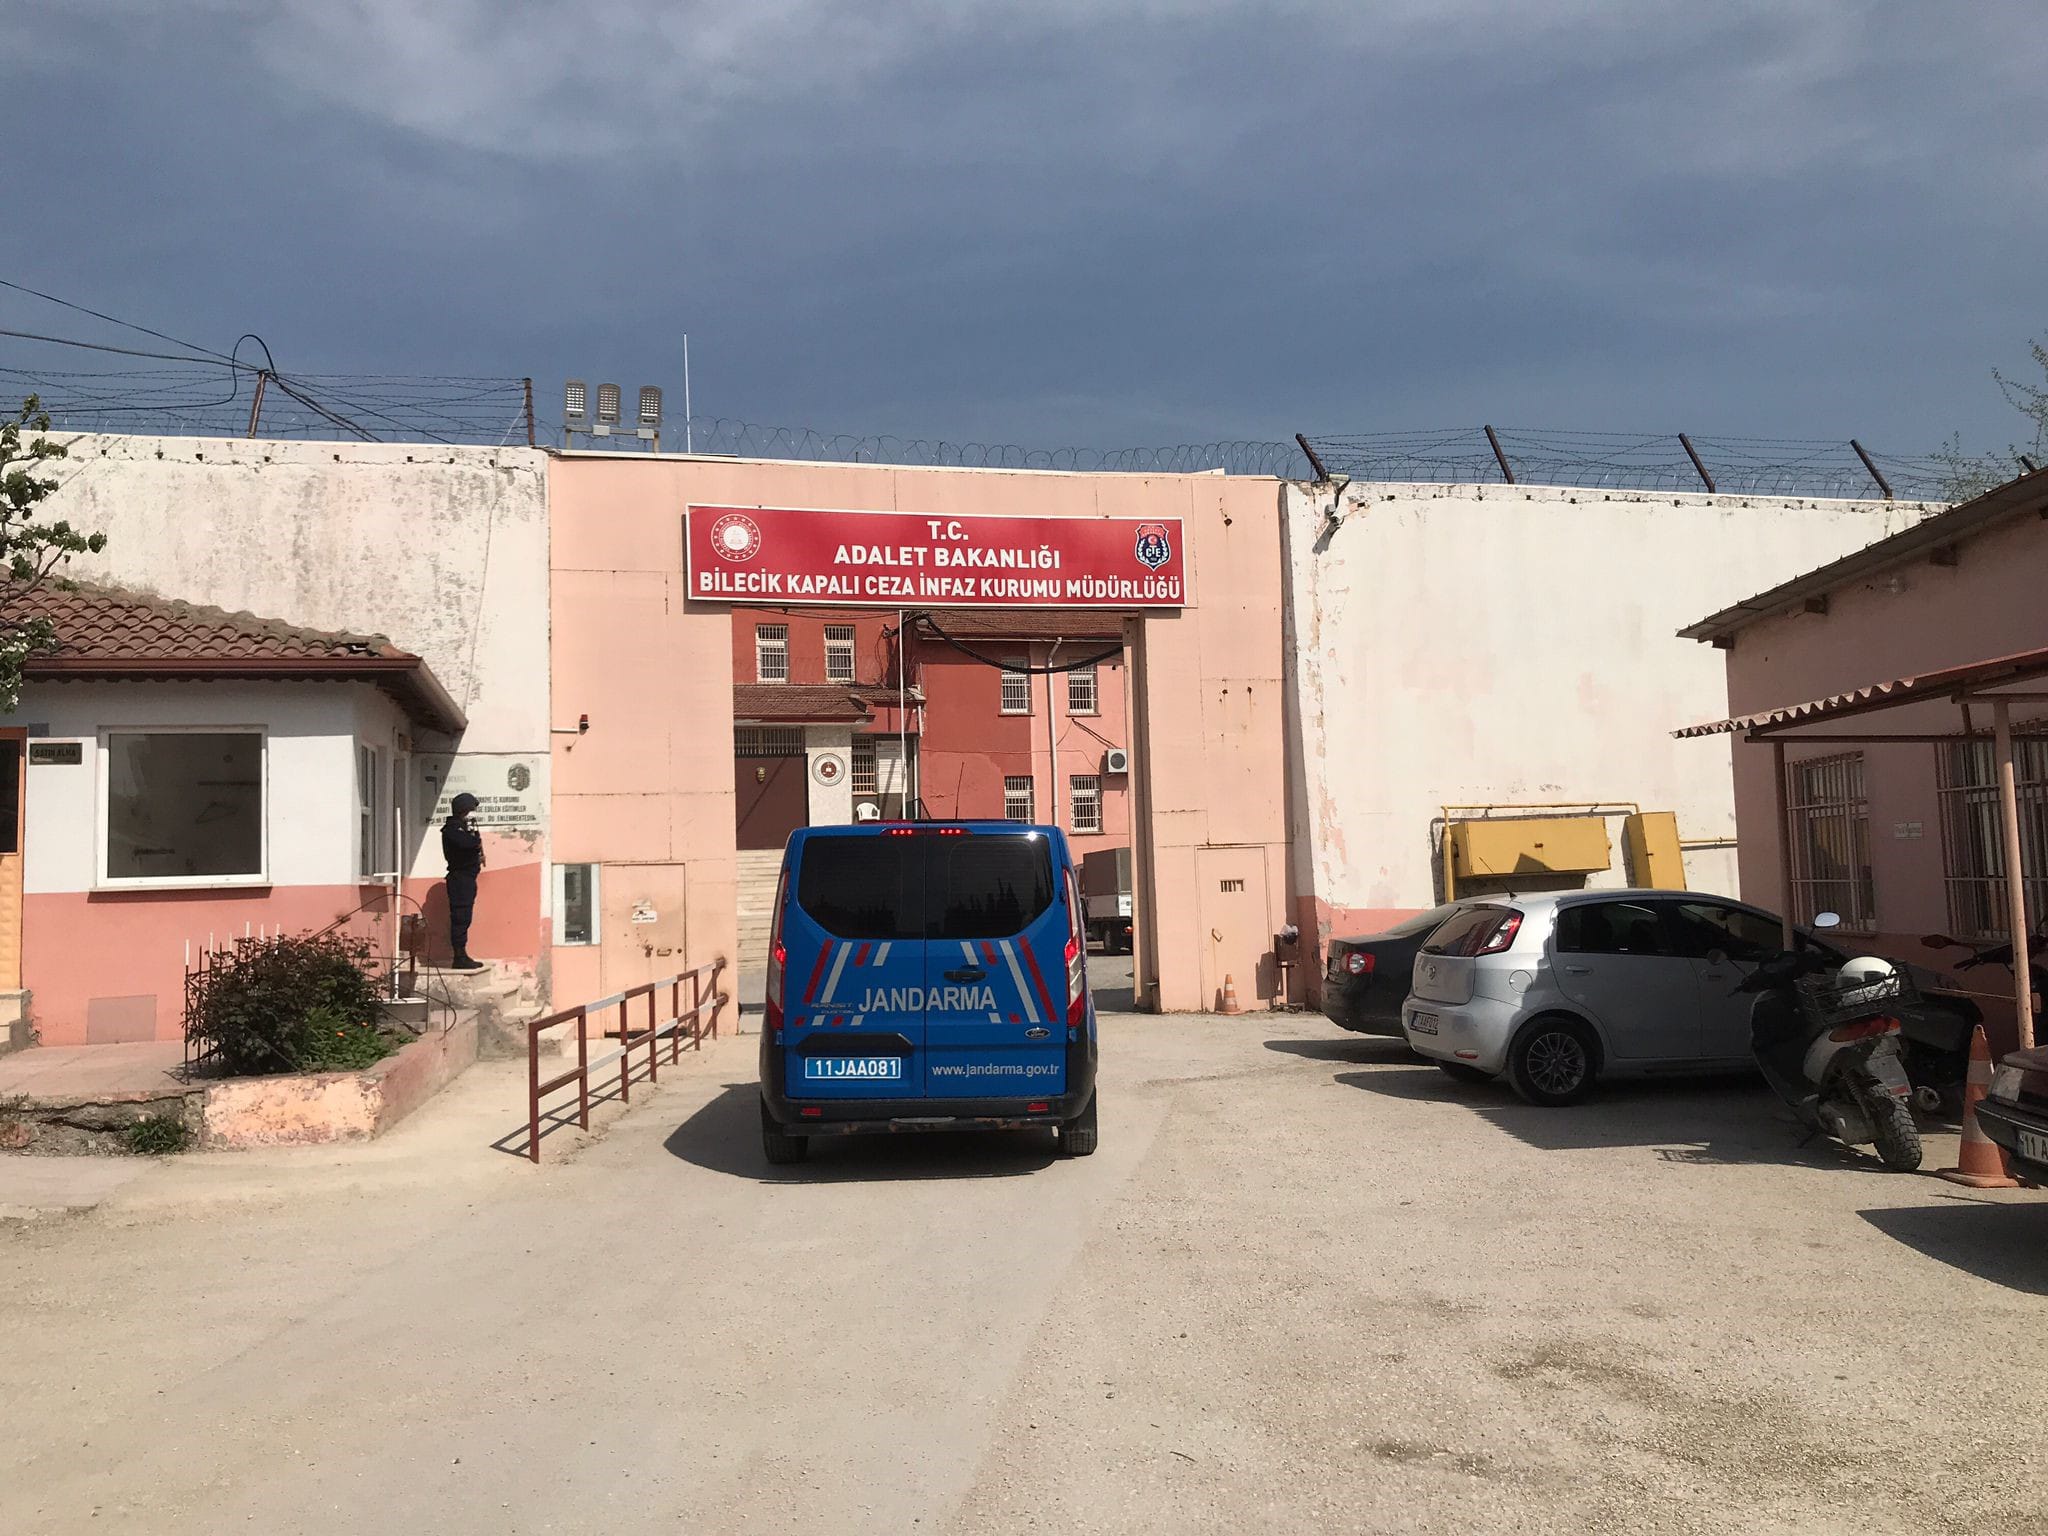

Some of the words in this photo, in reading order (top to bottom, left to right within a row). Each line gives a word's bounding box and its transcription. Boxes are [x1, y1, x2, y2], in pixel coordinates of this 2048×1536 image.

[927, 520, 968, 541] T.C.
[834, 545, 928, 567] ADALET
[935, 545, 1060, 569] BAKANLIĞI
[700, 567, 783, 593] BİLECİK
[787, 574, 860, 595] KAPALI
[865, 576, 916, 596] CEZA
[919, 572, 976, 597] İNFAZ
[980, 578, 1061, 598] KURUMU
[1066, 575, 1180, 599] MÜDÜRLÜĞÜ
[858, 986, 997, 1012] JANDARMA
[932, 1063, 1060, 1079] www.jandarma.gov.tr
